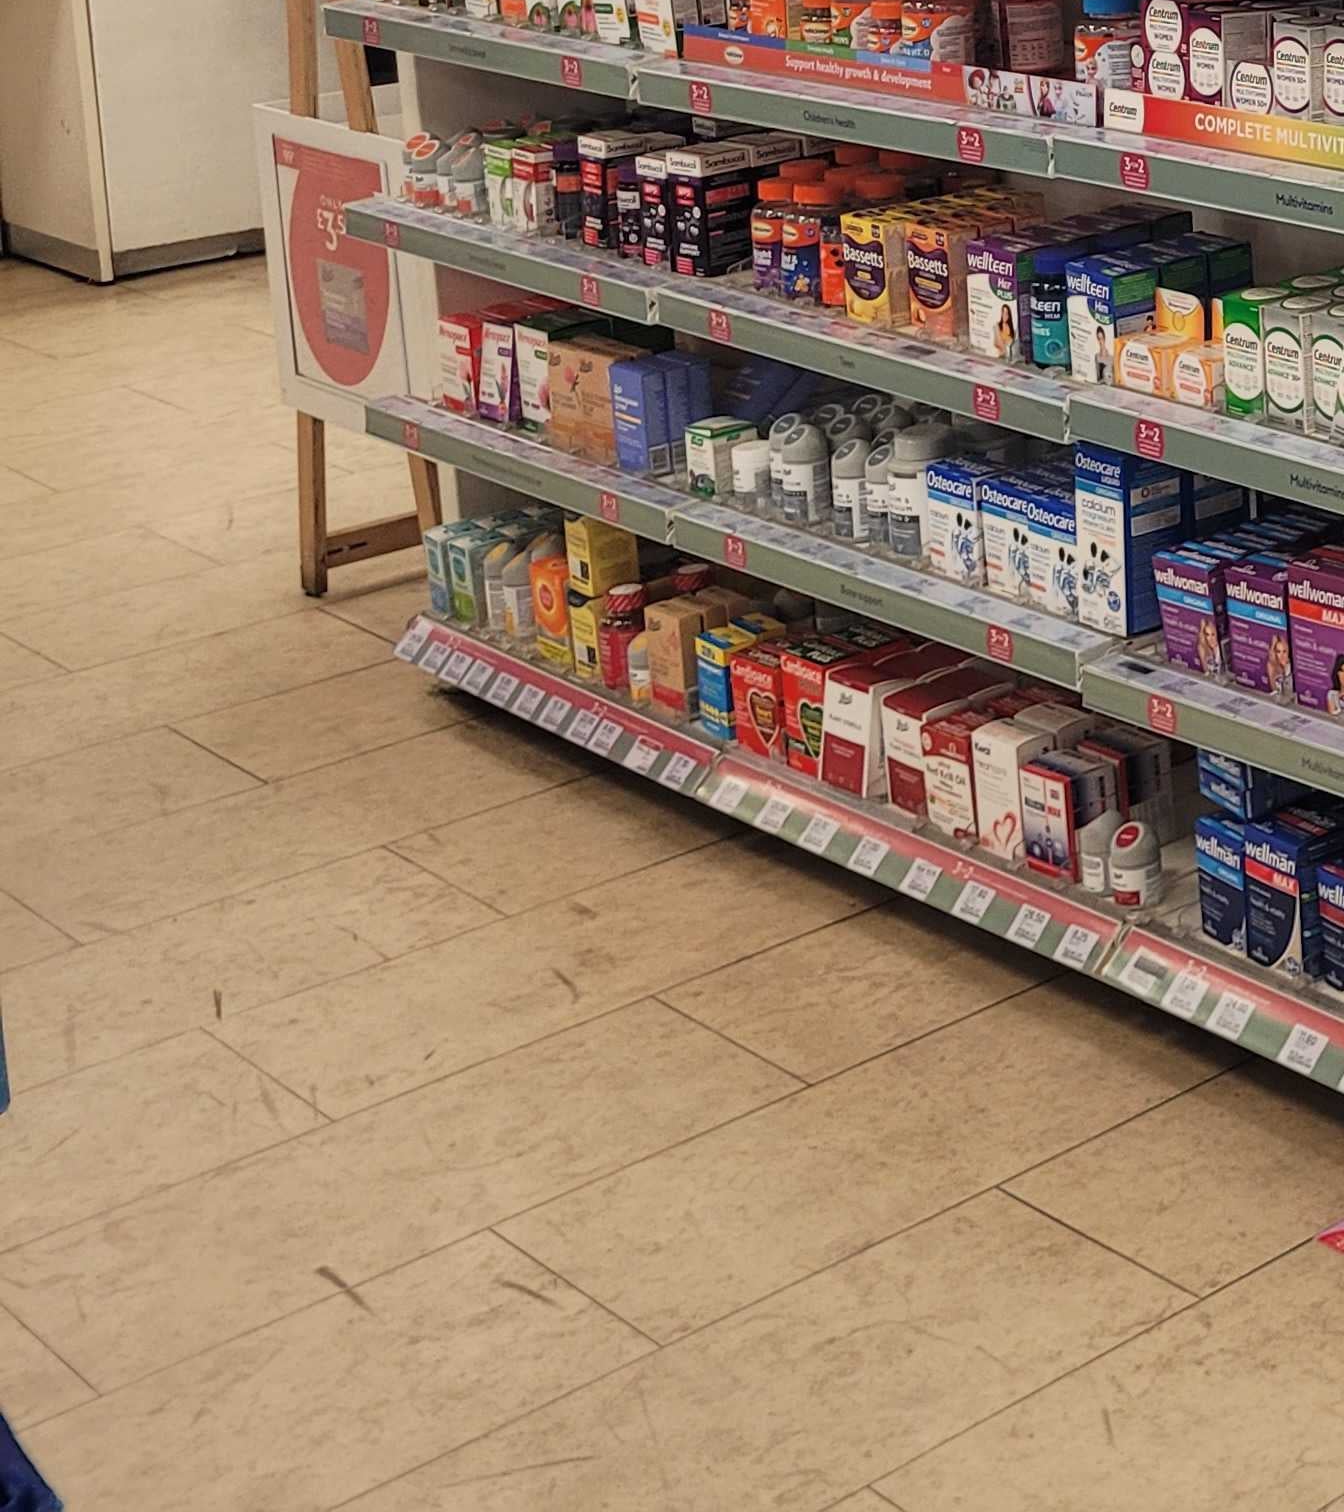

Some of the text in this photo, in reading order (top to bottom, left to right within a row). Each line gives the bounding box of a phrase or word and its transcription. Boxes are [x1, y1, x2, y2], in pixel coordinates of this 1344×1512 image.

[786, 56, 814, 74] Support
[816, 60, 843, 78] healthy
[845, 65, 872, 82] growth
[881, 70, 932, 90] development
[1195, 114, 1272, 142] COMPLETE
[843, 244, 883, 268] Bassetts
[967, 252, 1013, 277] wellteen
[1075, 451, 1121, 480] Osteocare
[927, 471, 972, 500] Osteocare
[1245, 841, 1296, 877] wellman
